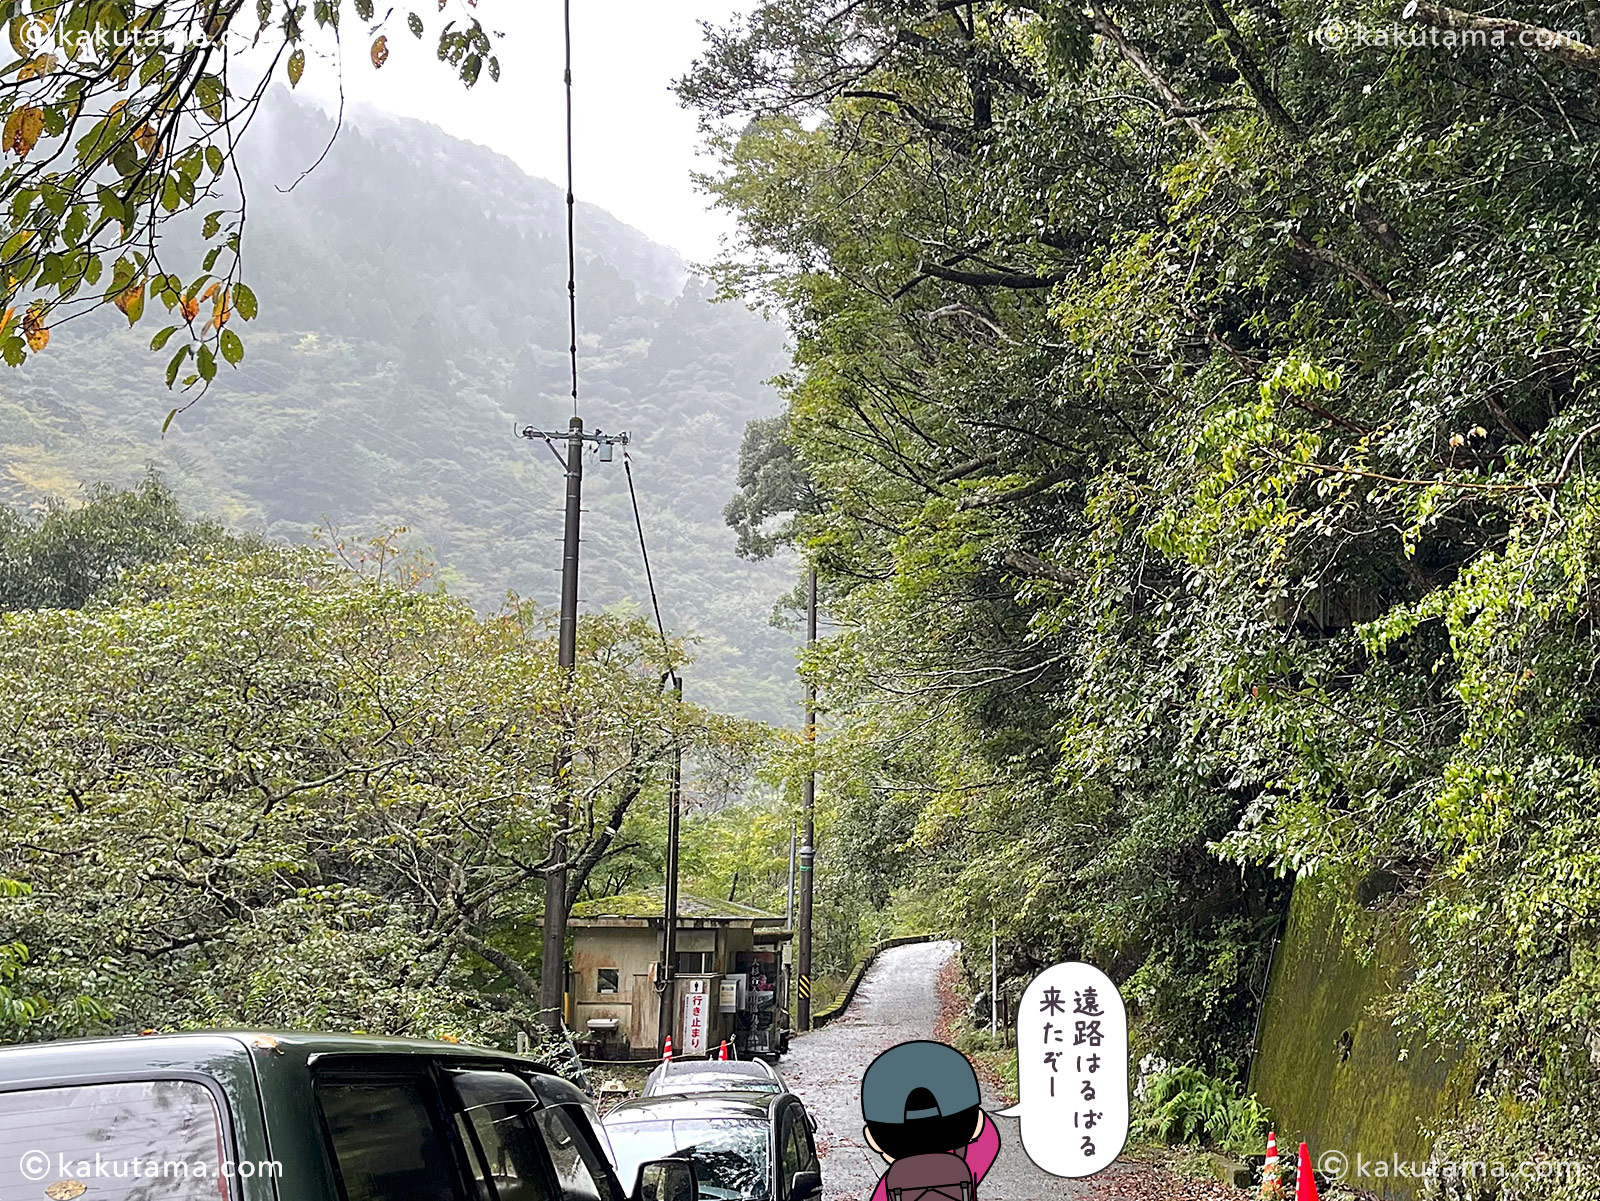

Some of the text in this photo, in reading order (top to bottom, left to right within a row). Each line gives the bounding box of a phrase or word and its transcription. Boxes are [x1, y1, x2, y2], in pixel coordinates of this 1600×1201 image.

[691, 995, 703, 1049] 行き止まり
